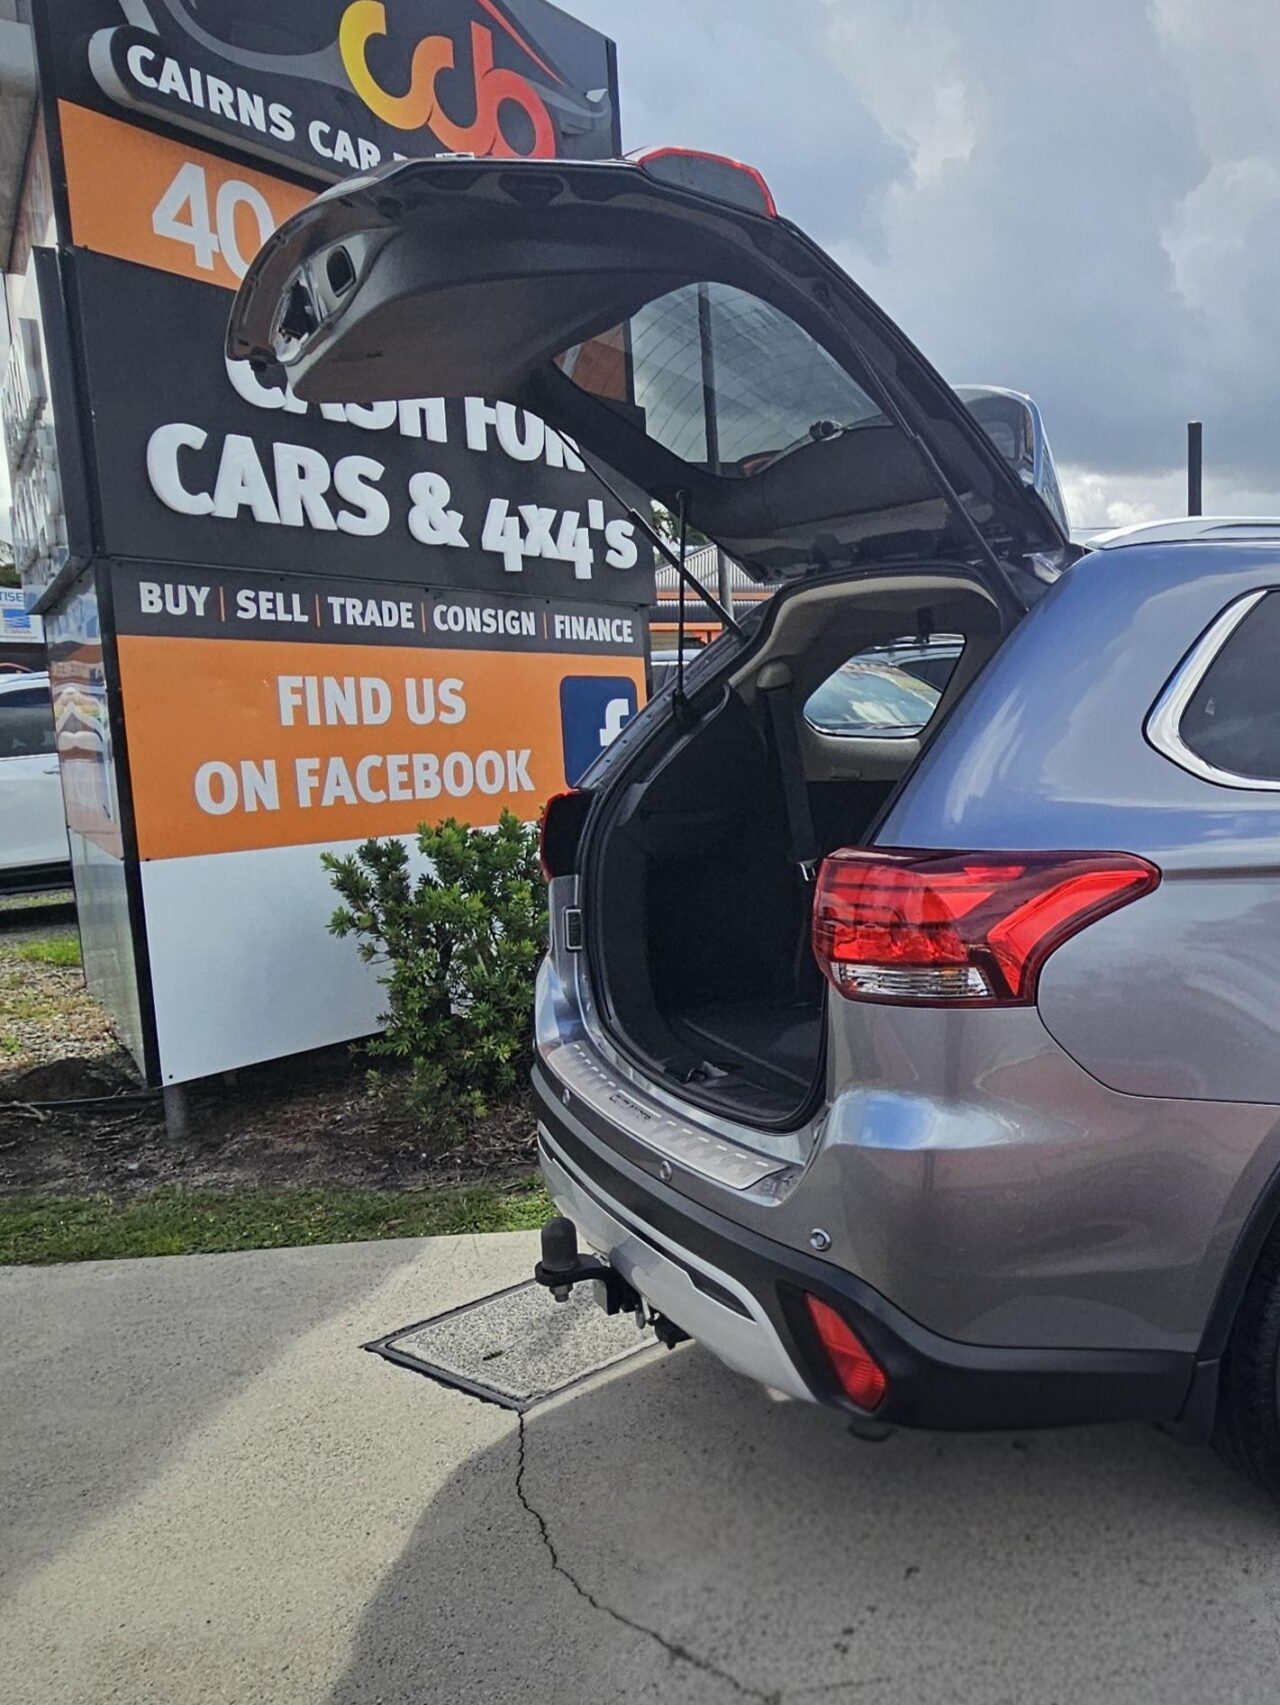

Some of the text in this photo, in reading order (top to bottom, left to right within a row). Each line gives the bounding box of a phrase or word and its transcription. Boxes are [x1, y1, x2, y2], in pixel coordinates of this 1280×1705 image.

[127, 45, 380, 170] CAIRNS CAR
[147, 423, 390, 536] CARS
[408, 471, 470, 548] &
[139, 582, 634, 643] BUY SELL TRADE CONSIGN FINANCE
[278, 675, 467, 727] FIND US
[194, 748, 535, 816] ON FACEBOOK
